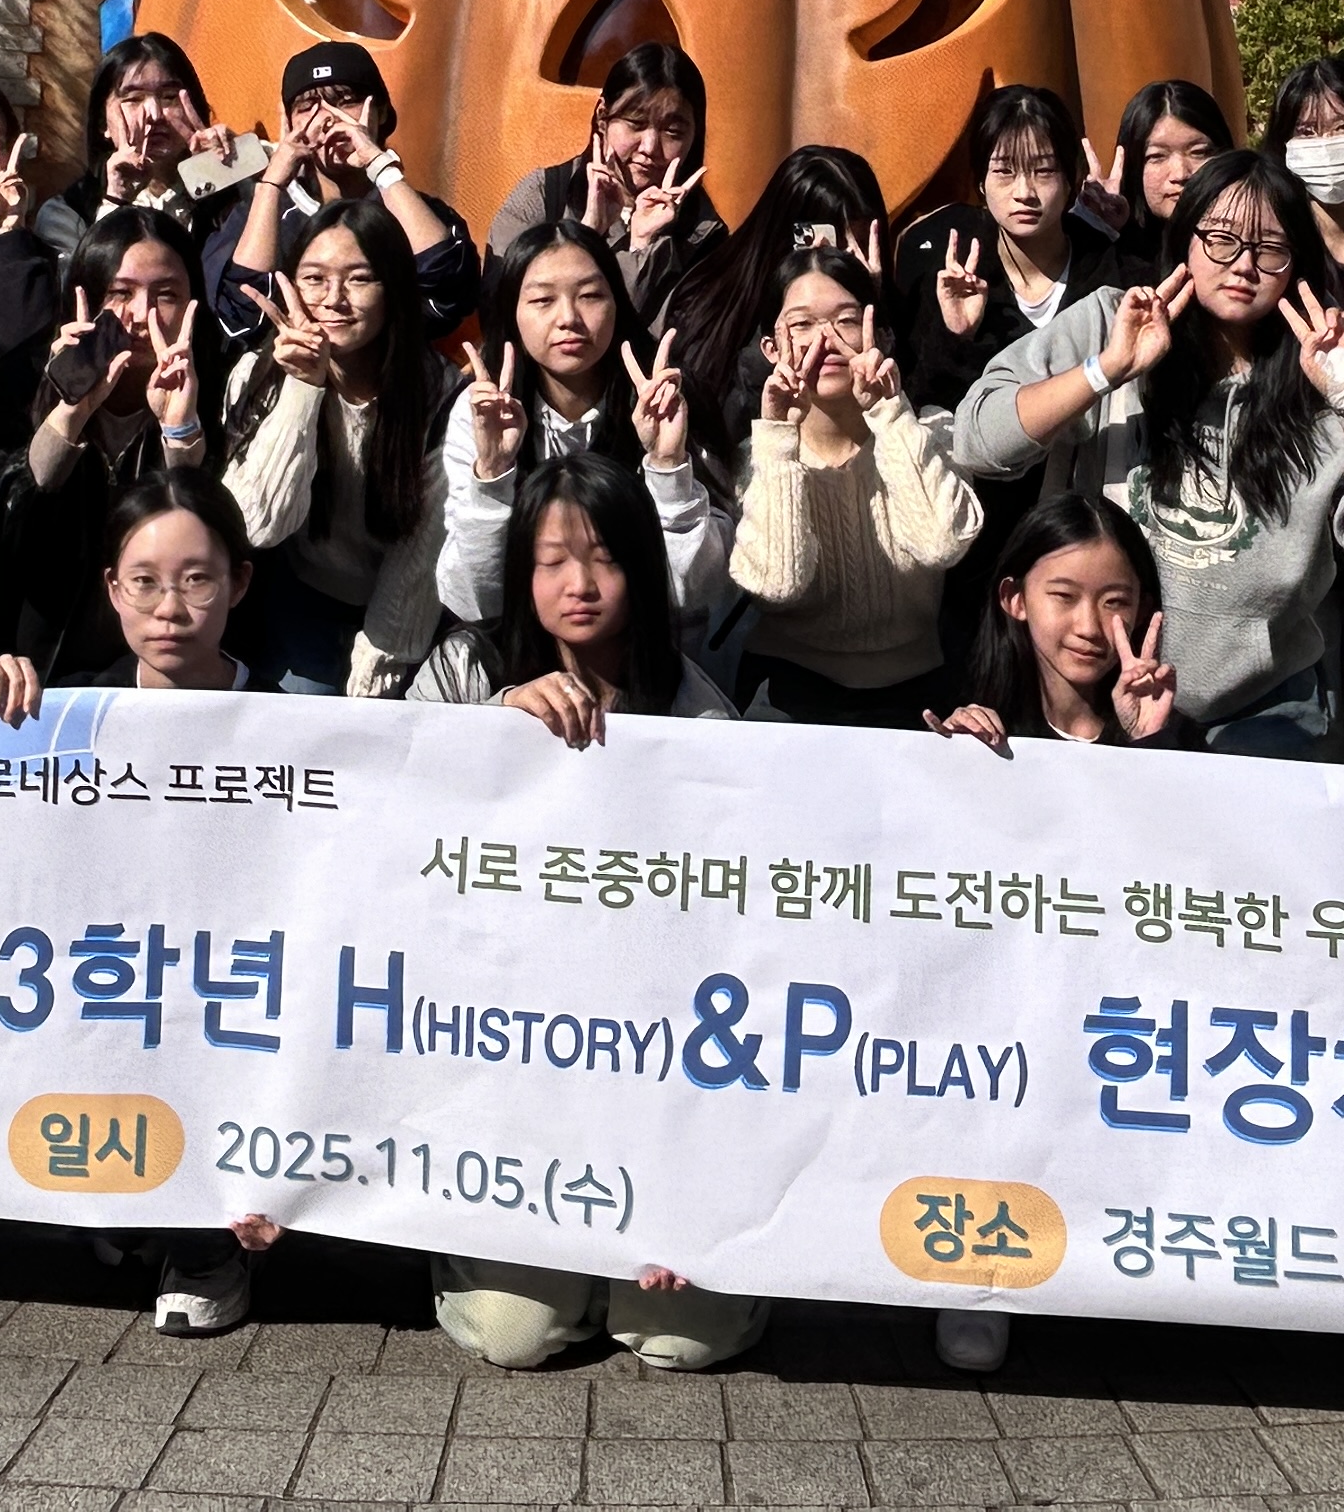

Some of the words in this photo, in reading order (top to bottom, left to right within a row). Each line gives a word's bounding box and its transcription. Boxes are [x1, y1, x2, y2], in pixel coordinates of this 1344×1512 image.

[165, 764, 340, 812] 프로젝트
[420, 836, 522, 895] 서로
[538, 845, 747, 916] 존중하며
[768, 858, 872, 924] 함께
[889, 870, 1106, 938] 도전하는
[1123, 880, 1289, 954] 행복한
[40, 1113, 147, 1178] 일시
[215, 1121, 635, 1234] 2025.11.05.(수)
[913, 1193, 1033, 1264] 장소
